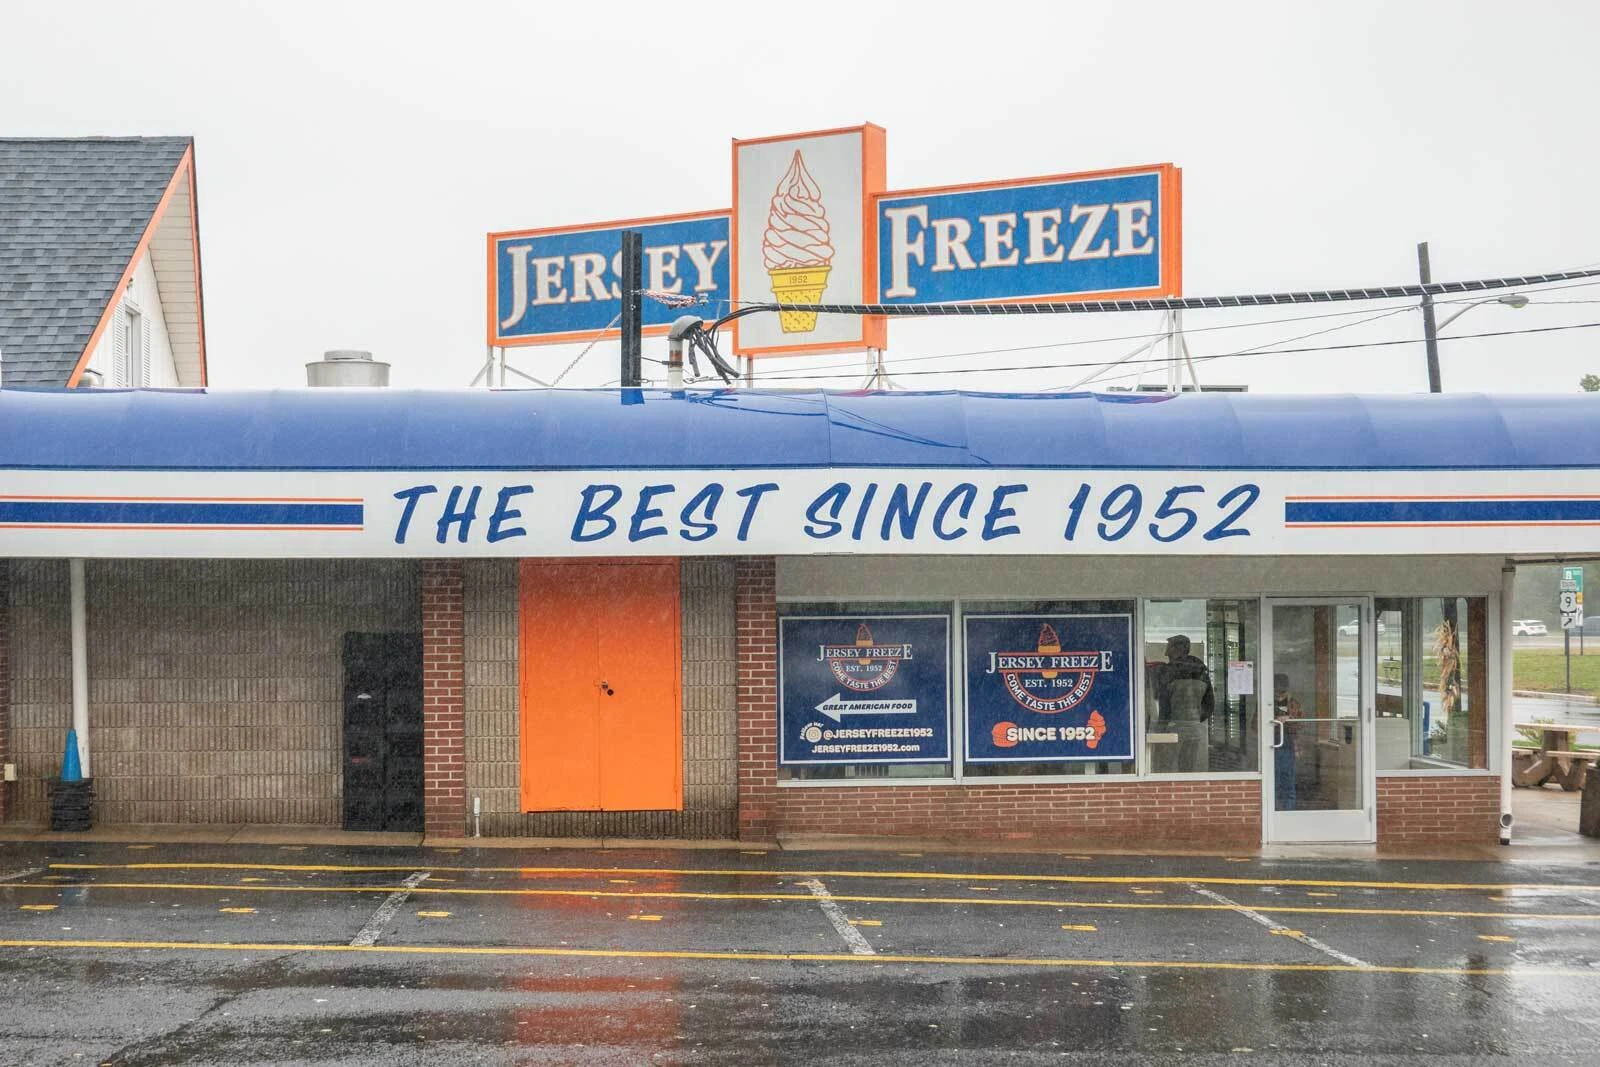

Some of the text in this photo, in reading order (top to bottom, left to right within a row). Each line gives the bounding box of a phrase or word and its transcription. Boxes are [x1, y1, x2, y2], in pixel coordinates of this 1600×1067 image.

[885, 200, 1155, 298] FREEZE
[789, 275, 808, 284] 1952
[393, 482, 1260, 544] THE BEST SINCE 1952
[1565, 596, 1572, 609] 9
[817, 644, 912, 661] JERSEY FREEZE
[986, 651, 1113, 674] JERSEY FREEZE
[846, 678, 869, 689] TASTE
[870, 676, 885, 688] THE
[883, 660, 897, 680] BEST
[1025, 679, 1073, 688] EST. 1952
[1007, 674, 1091, 710] COME TASTE THE BEST
[822, 703, 848, 711] GREAT
[849, 703, 891, 711] AMERICAN
[823, 728, 933, 740] @JERSEYFREEZE1952
[1007, 727, 1096, 742] SINCE 1952
[811, 743, 920, 754] JERSEYFREEZE1952.com
